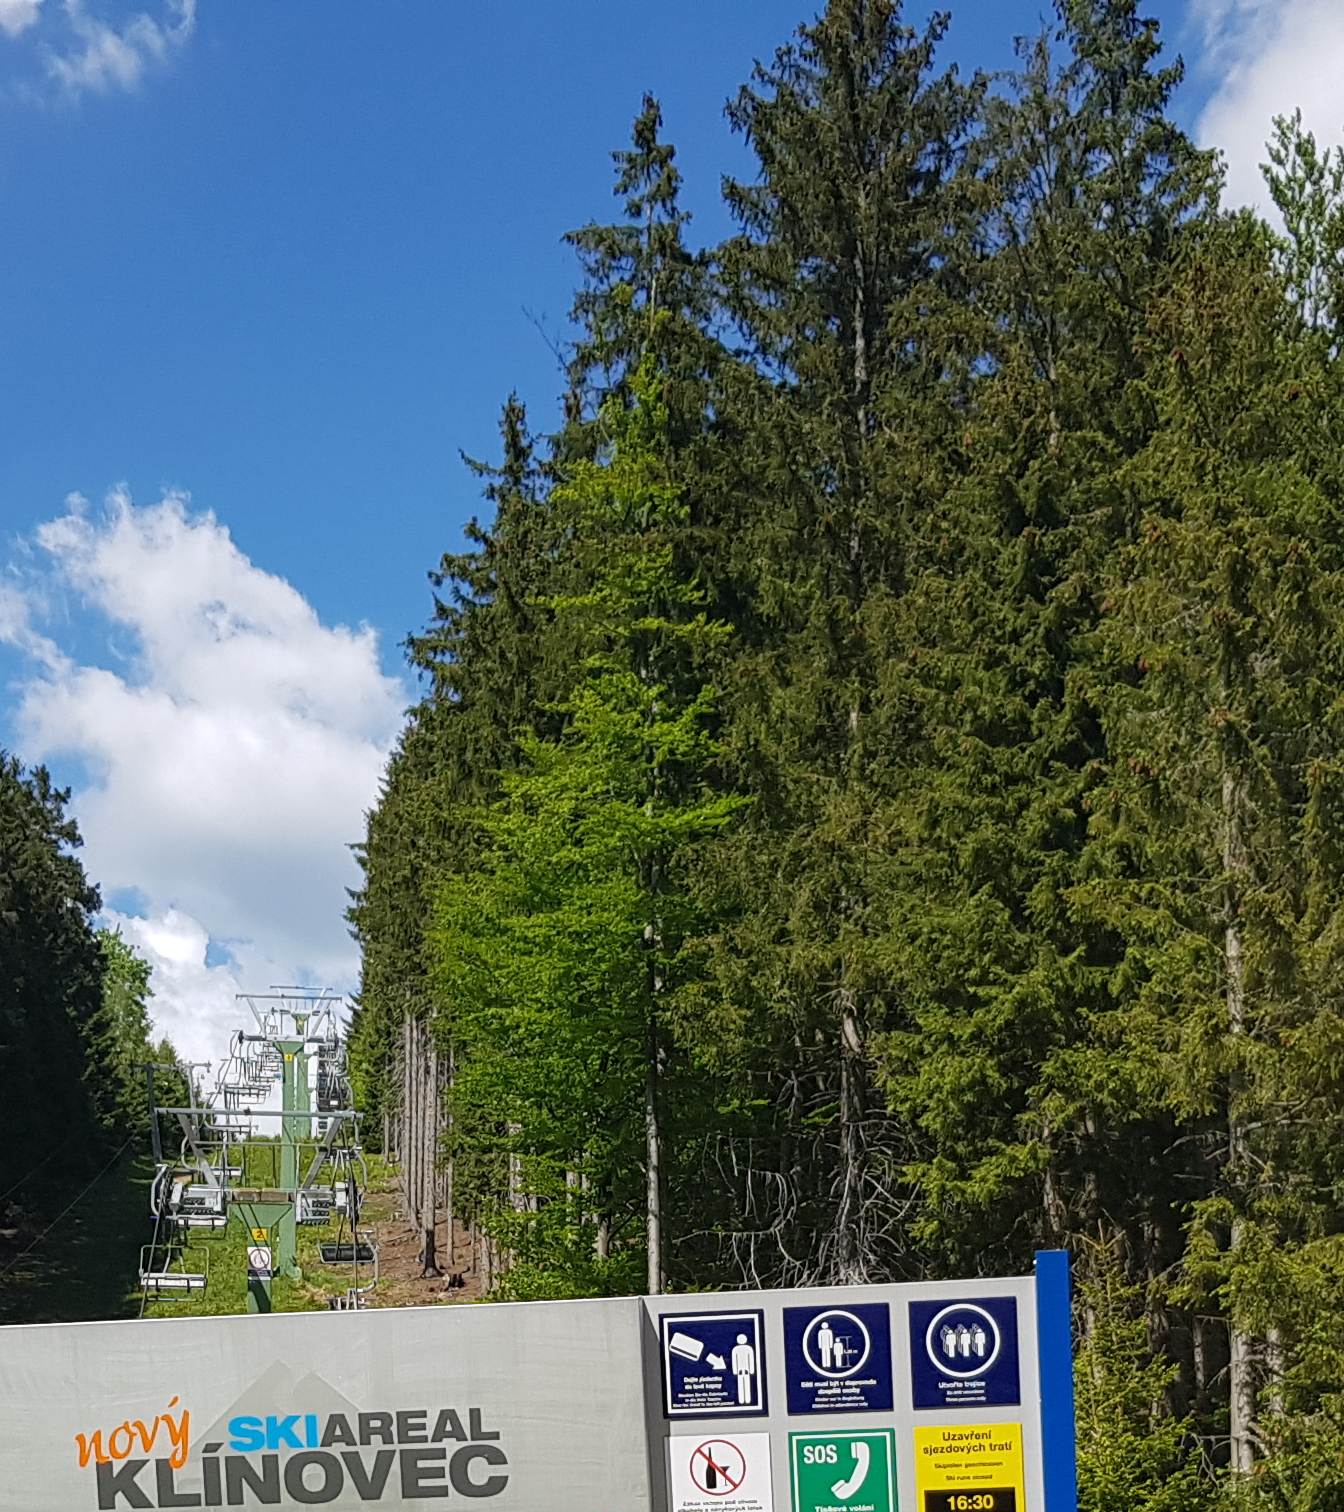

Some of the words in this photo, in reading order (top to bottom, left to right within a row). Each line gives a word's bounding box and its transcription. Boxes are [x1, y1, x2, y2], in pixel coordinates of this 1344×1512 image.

[75, 1396, 190, 1469] nový
[942, 1430, 991, 1441] Uzavření
[803, 1444, 837, 1464] SOS
[923, 1443, 986, 1456] sjezdových
[989, 1441, 1012, 1451] tratí
[95, 1443, 509, 1510] KLÍNOVEC
[947, 1494, 994, 1510] 16:30
